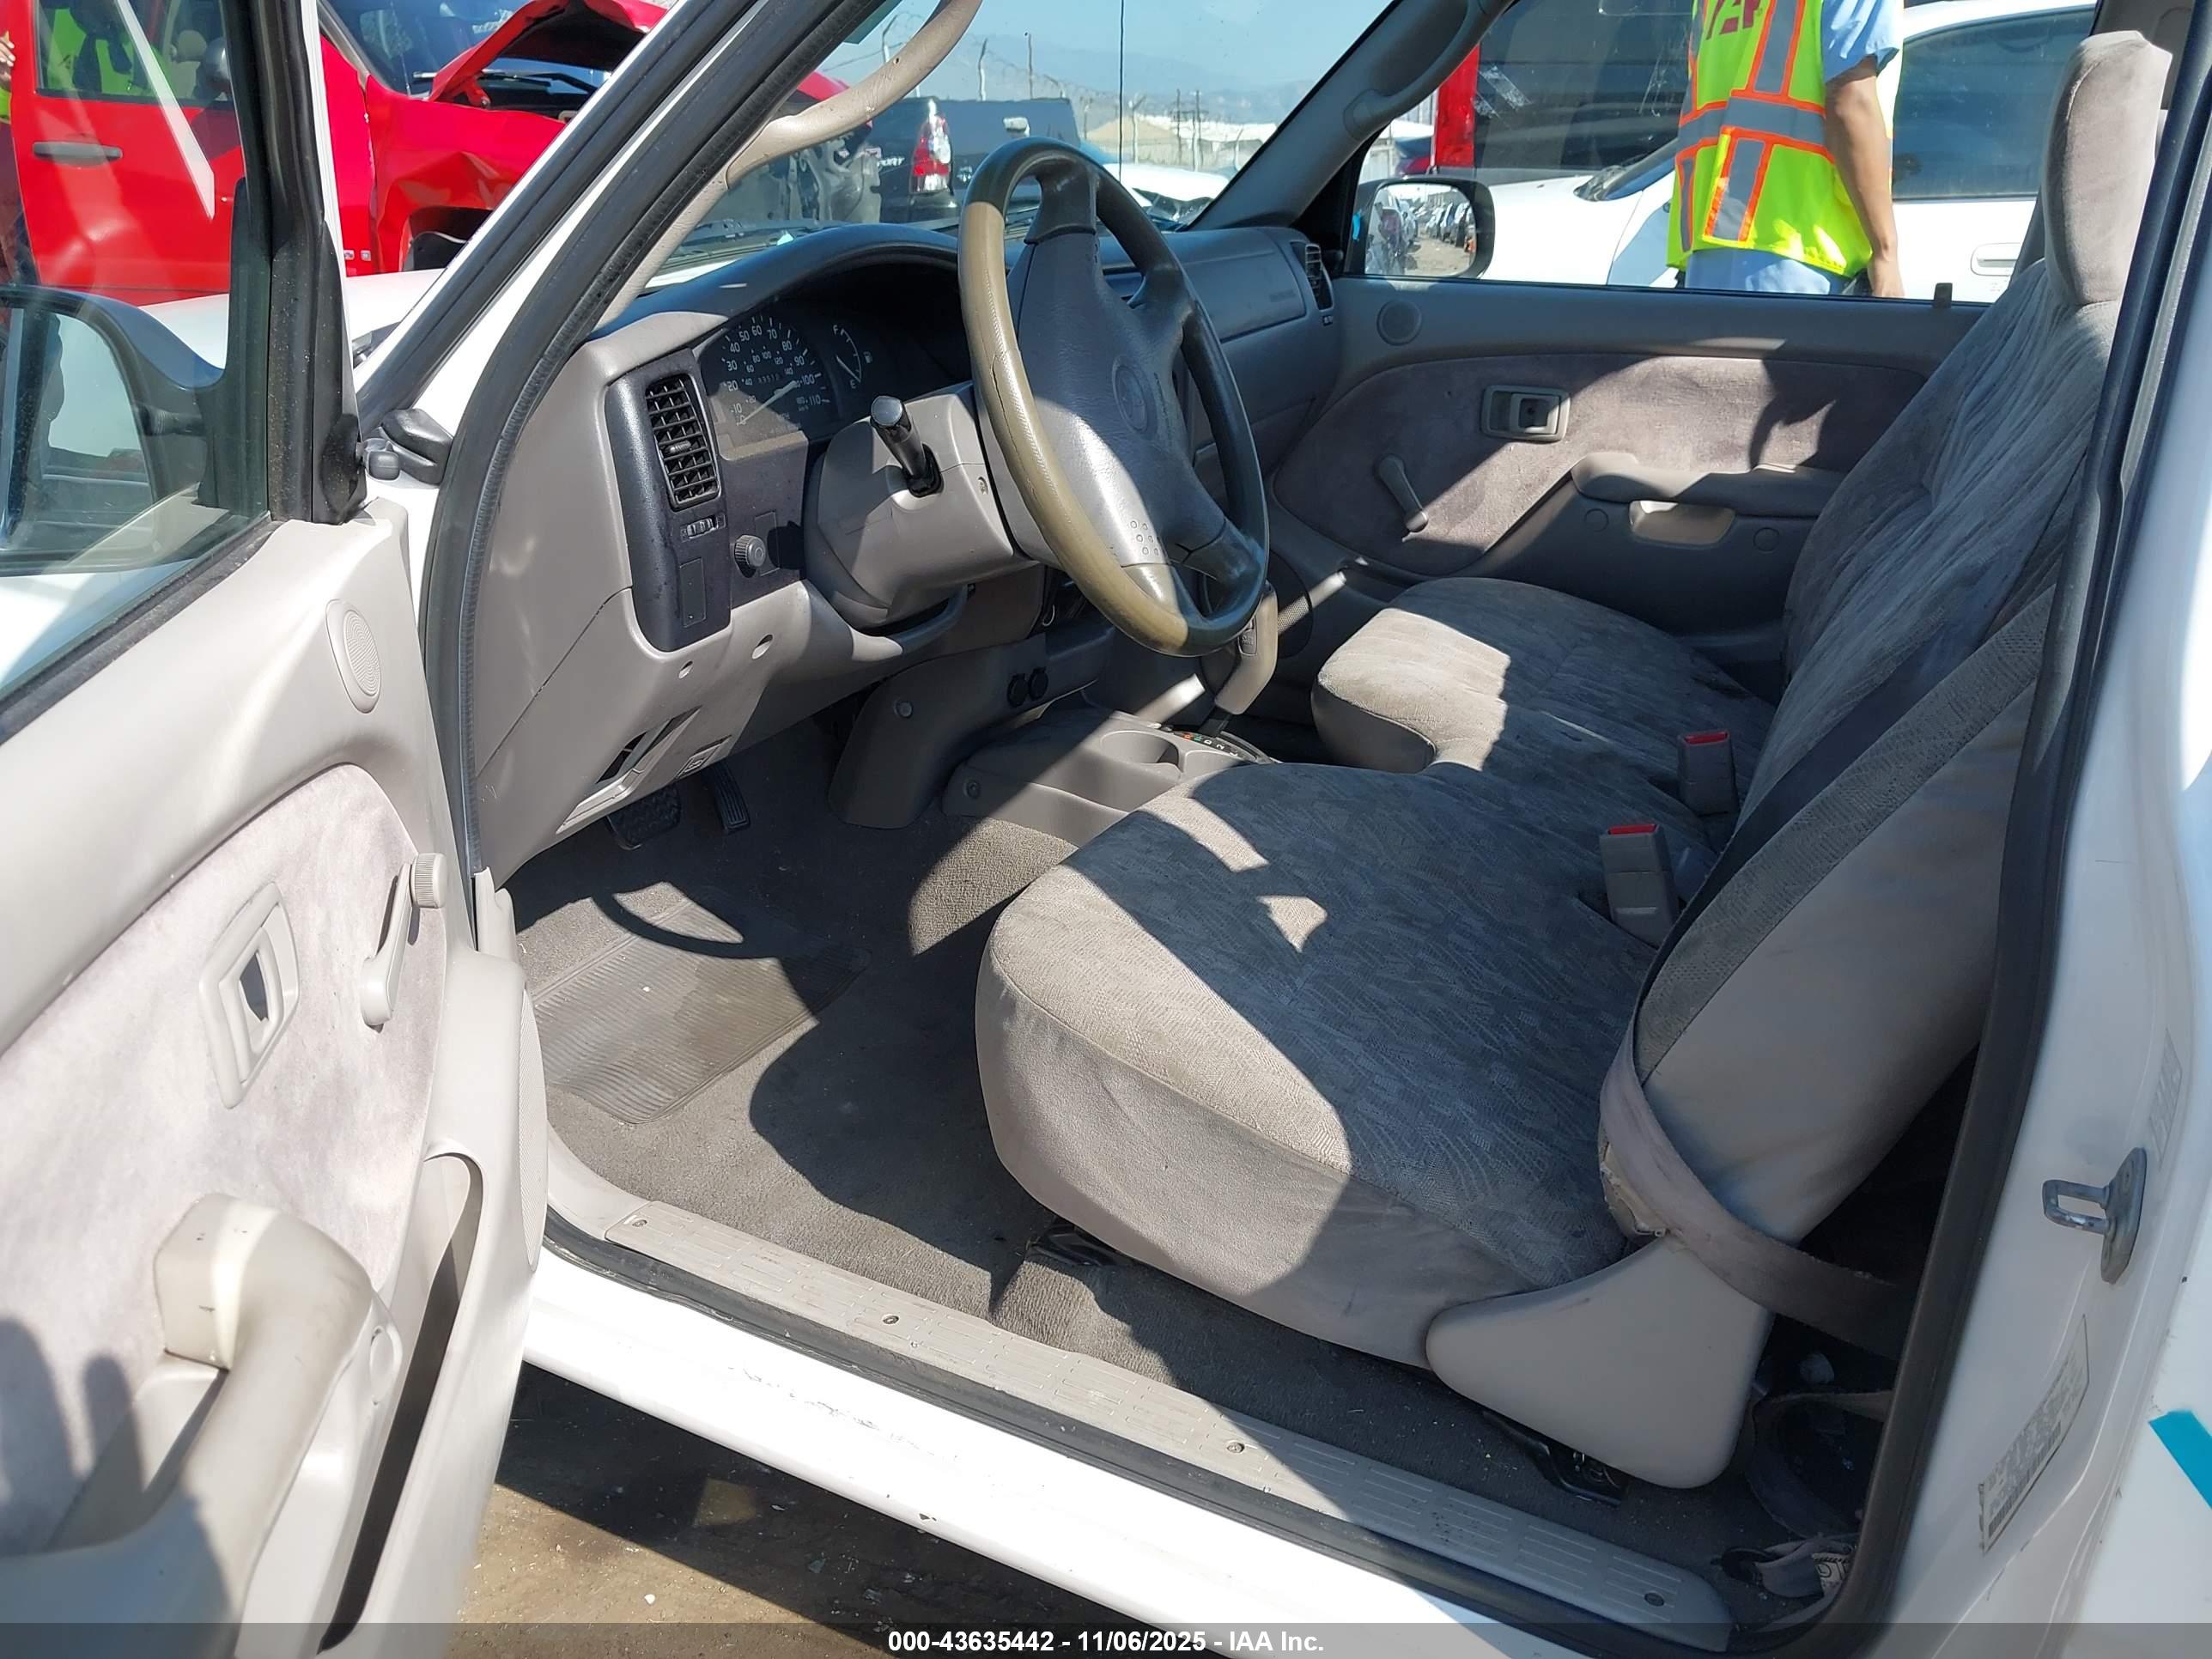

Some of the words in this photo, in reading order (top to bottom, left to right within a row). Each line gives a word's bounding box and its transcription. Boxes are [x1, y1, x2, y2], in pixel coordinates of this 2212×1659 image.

[751, 325, 763, 337] 60
[767, 329, 778, 340] 70
[832, 325, 839, 335] F
[738, 331, 750, 343] 50
[730, 342, 741, 353] 40
[781, 340, 793, 351] 80
[761, 350, 772, 361] 100
[774, 356, 783, 366] 120
[726, 360, 738, 372] 30
[794, 356, 805, 367] 90
[746, 364, 755, 374] 60
[744, 378, 753, 386] 40
[802, 374, 816, 386] 100
[727, 380, 738, 392] 20
[809, 394, 821, 406] 110
[732, 403, 743, 414] 10
